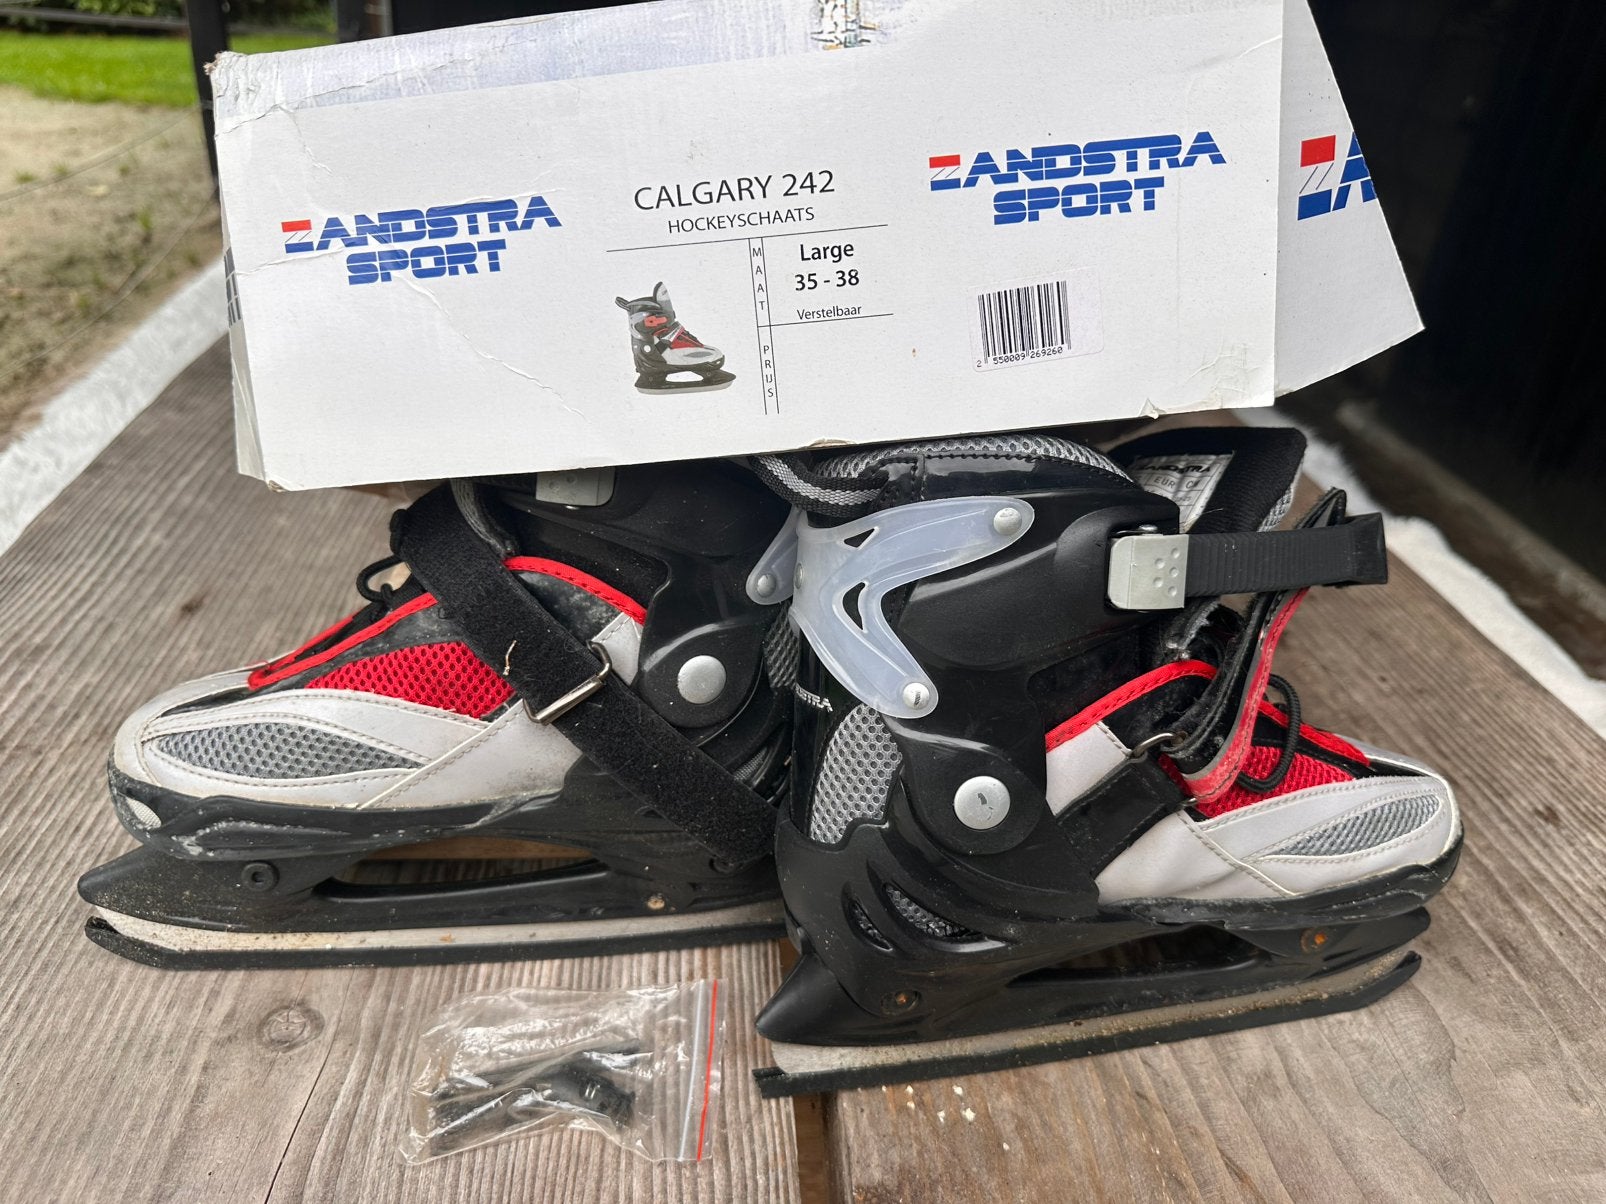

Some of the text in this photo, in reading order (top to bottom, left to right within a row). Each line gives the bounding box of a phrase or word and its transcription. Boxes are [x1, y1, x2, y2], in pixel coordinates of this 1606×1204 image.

[929, 131, 1227, 191] ZANDSTRA
[634, 170, 836, 210] CALGARY 242
[993, 176, 1165, 225] SPORT
[281, 195, 563, 254] ZANDSTRA
[667, 206, 815, 234] HOCKEYSCHAATS
[346, 238, 507, 286] SPORT
[799, 243, 855, 264] Large
[794, 272, 819, 291] 35
[835, 268, 860, 288] 38
[796, 305, 862, 320] Verstelbaar
[976, 359, 983, 368] 2
[1030, 346, 1064, 359] 269260
[1153, 475, 1176, 489] EUR
